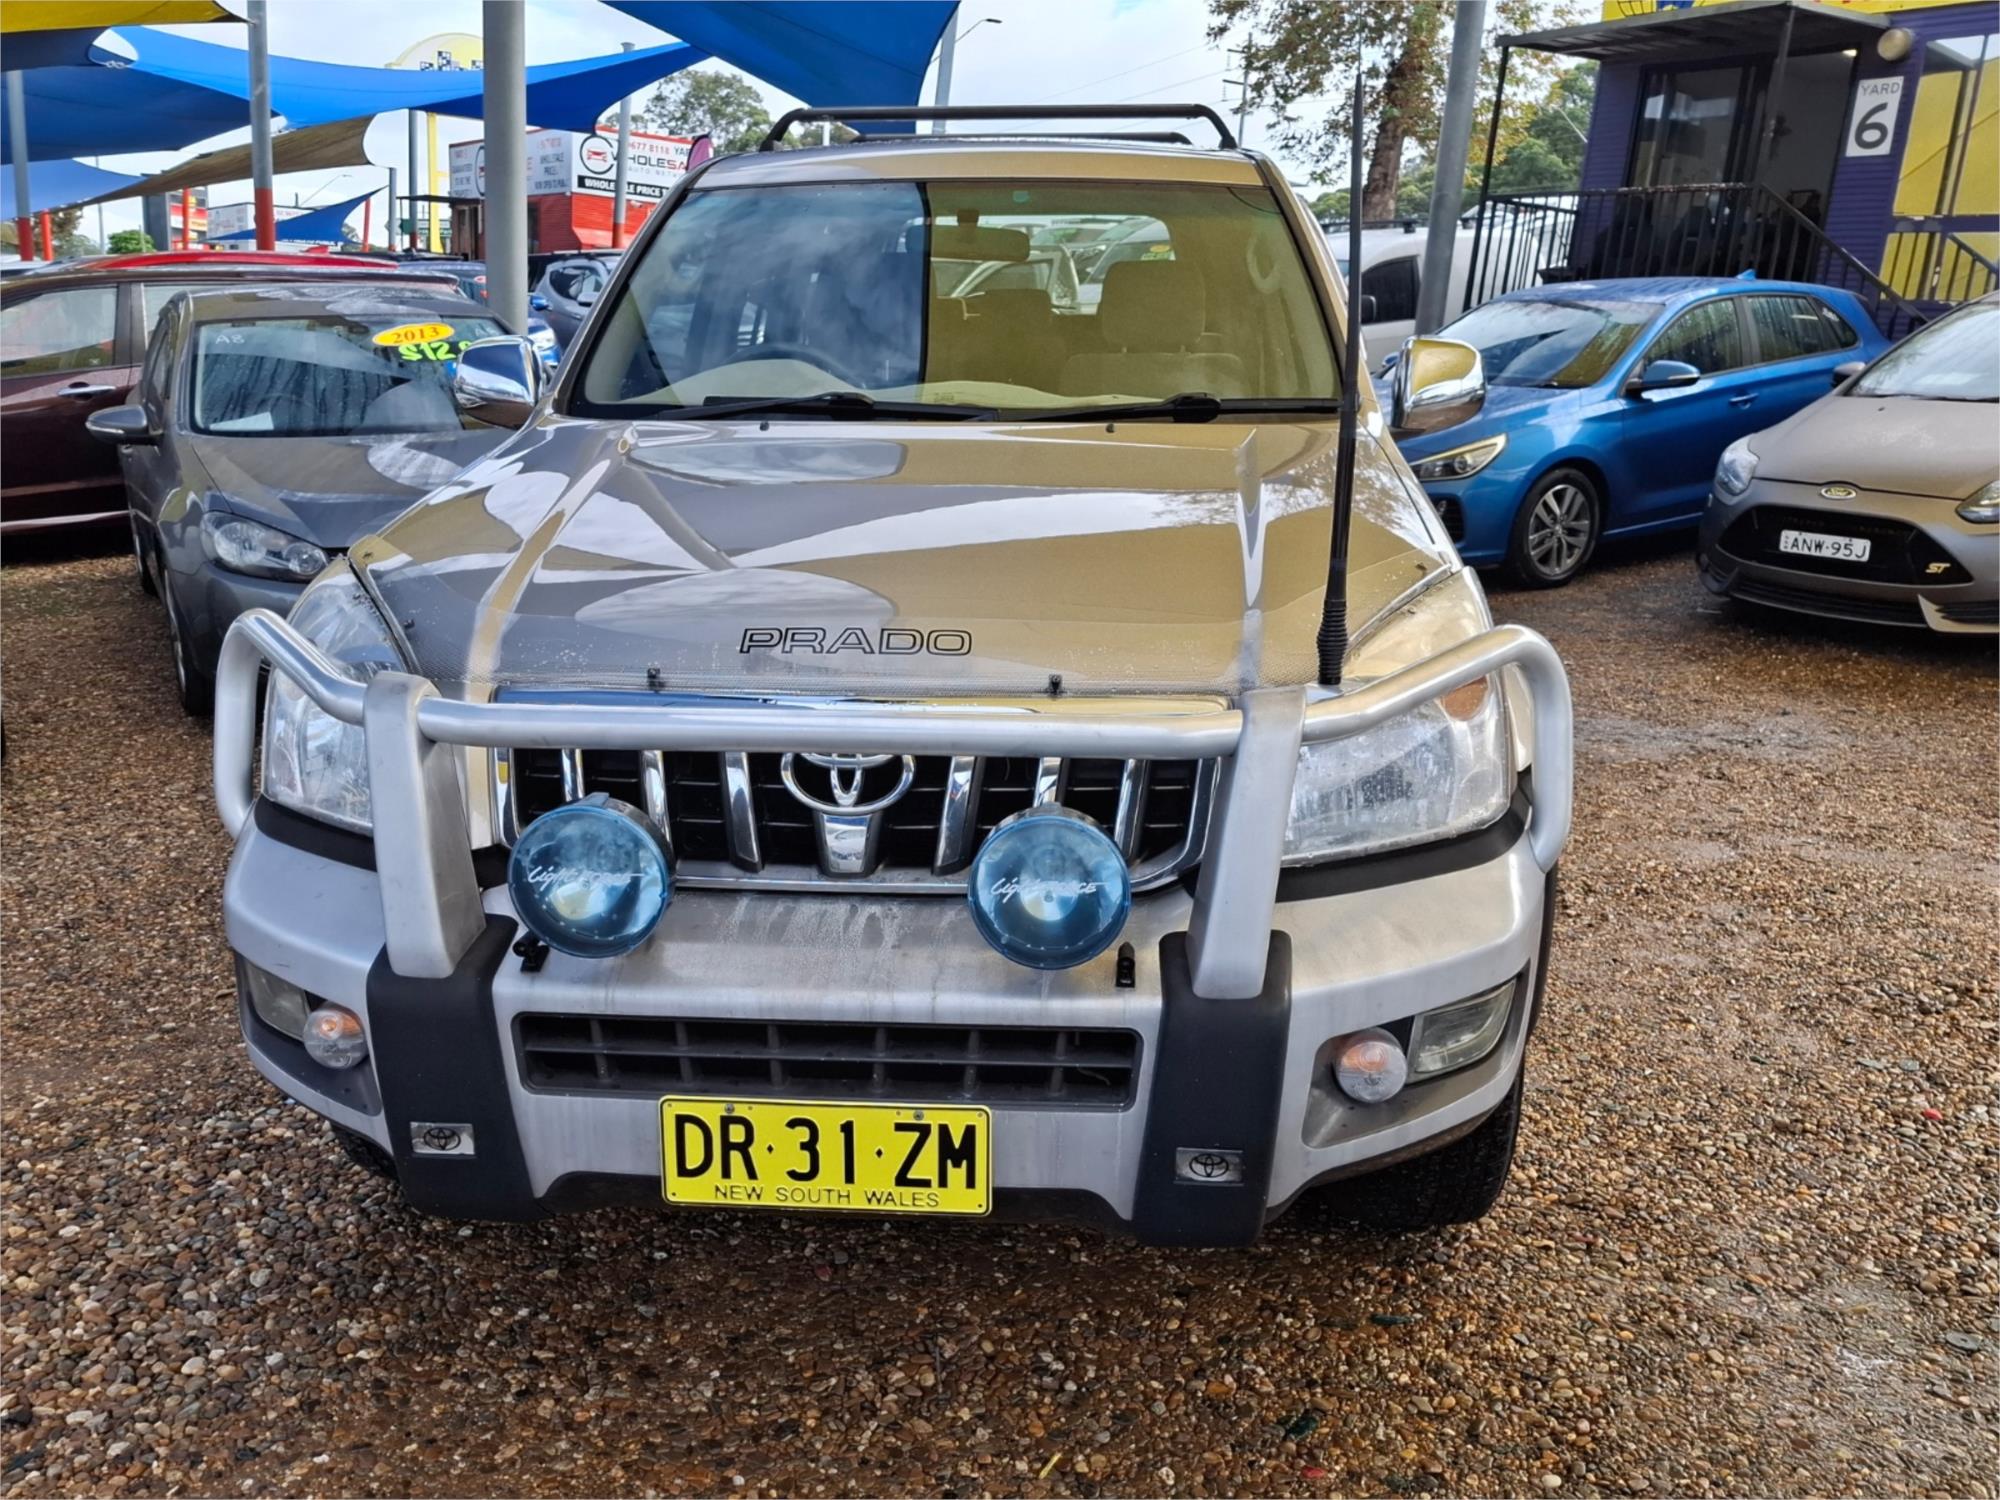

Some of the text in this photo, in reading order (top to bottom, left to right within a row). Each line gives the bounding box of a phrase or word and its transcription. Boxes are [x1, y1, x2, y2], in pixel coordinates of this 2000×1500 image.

[1861, 82, 1900, 96] YARD
[1854, 101, 1888, 150] 6
[584, 178, 636, 194] WHOLELE
[636, 184, 661, 197] PRICE
[391, 325, 440, 345] 2013
[1925, 562, 1951, 574] ST
[739, 627, 973, 656] PRADO
[714, 1184, 940, 1208] NEW SOUTH WALES
